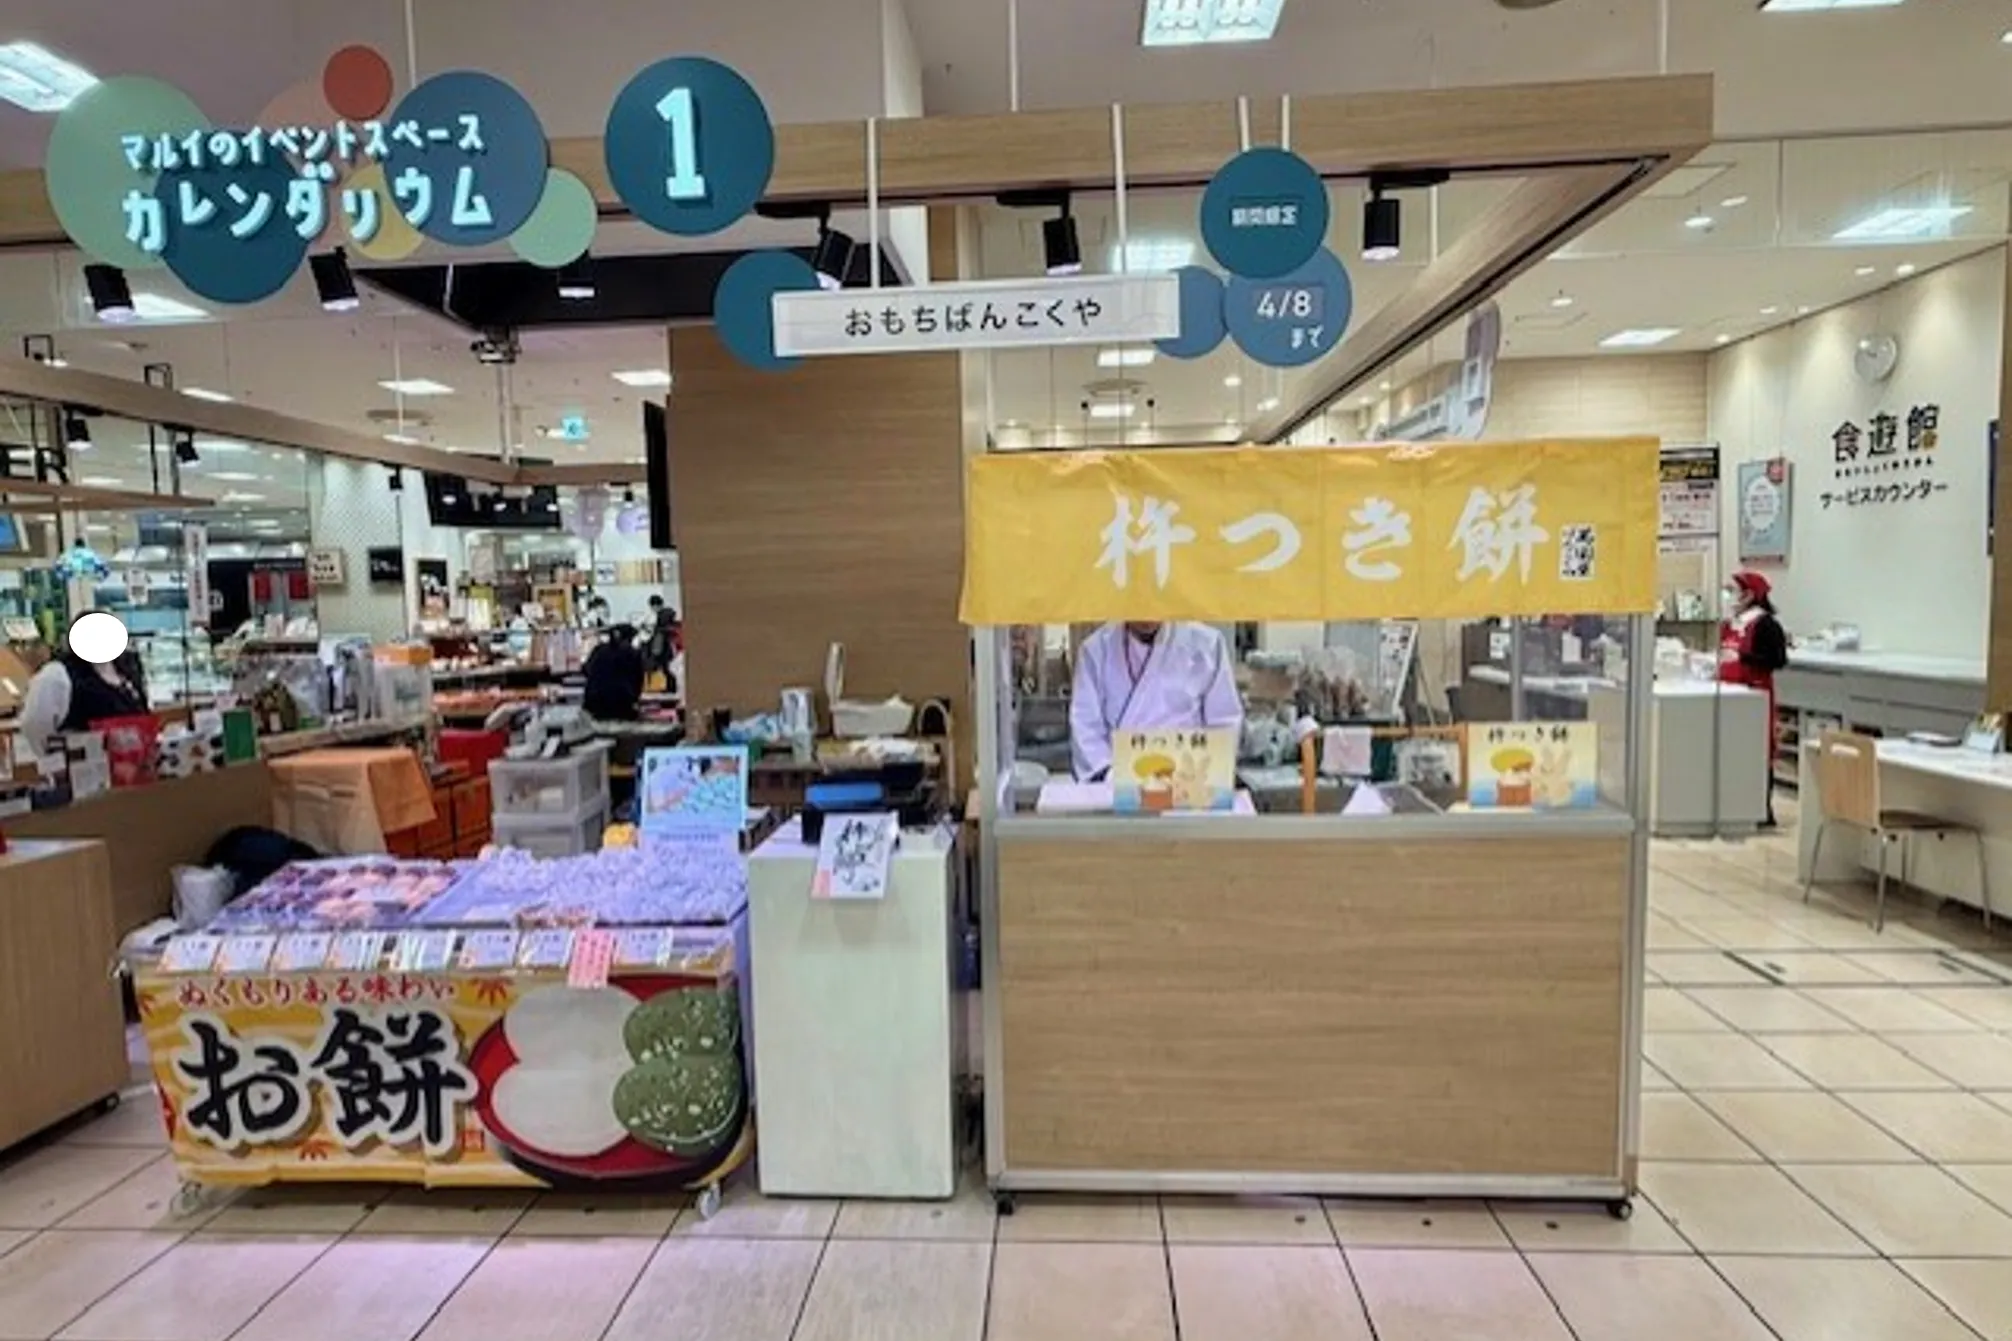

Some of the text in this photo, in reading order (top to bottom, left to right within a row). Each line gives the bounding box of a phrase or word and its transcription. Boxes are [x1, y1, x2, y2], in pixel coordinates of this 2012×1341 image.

[121, 113, 484, 172] マルイのイベントスペース
[656, 87, 704, 199] 1
[121, 163, 495, 254] カレンダリウム
[1256, 289, 1312, 318] 4/8
[1831, 402, 1940, 463] 食遊館
[1819, 478, 1949, 510] サービスカウンター
[1095, 482, 1549, 592] 杵つき餅
[178, 973, 456, 1008] ぬくもりある味わい
[180, 1010, 466, 1145] お餅
